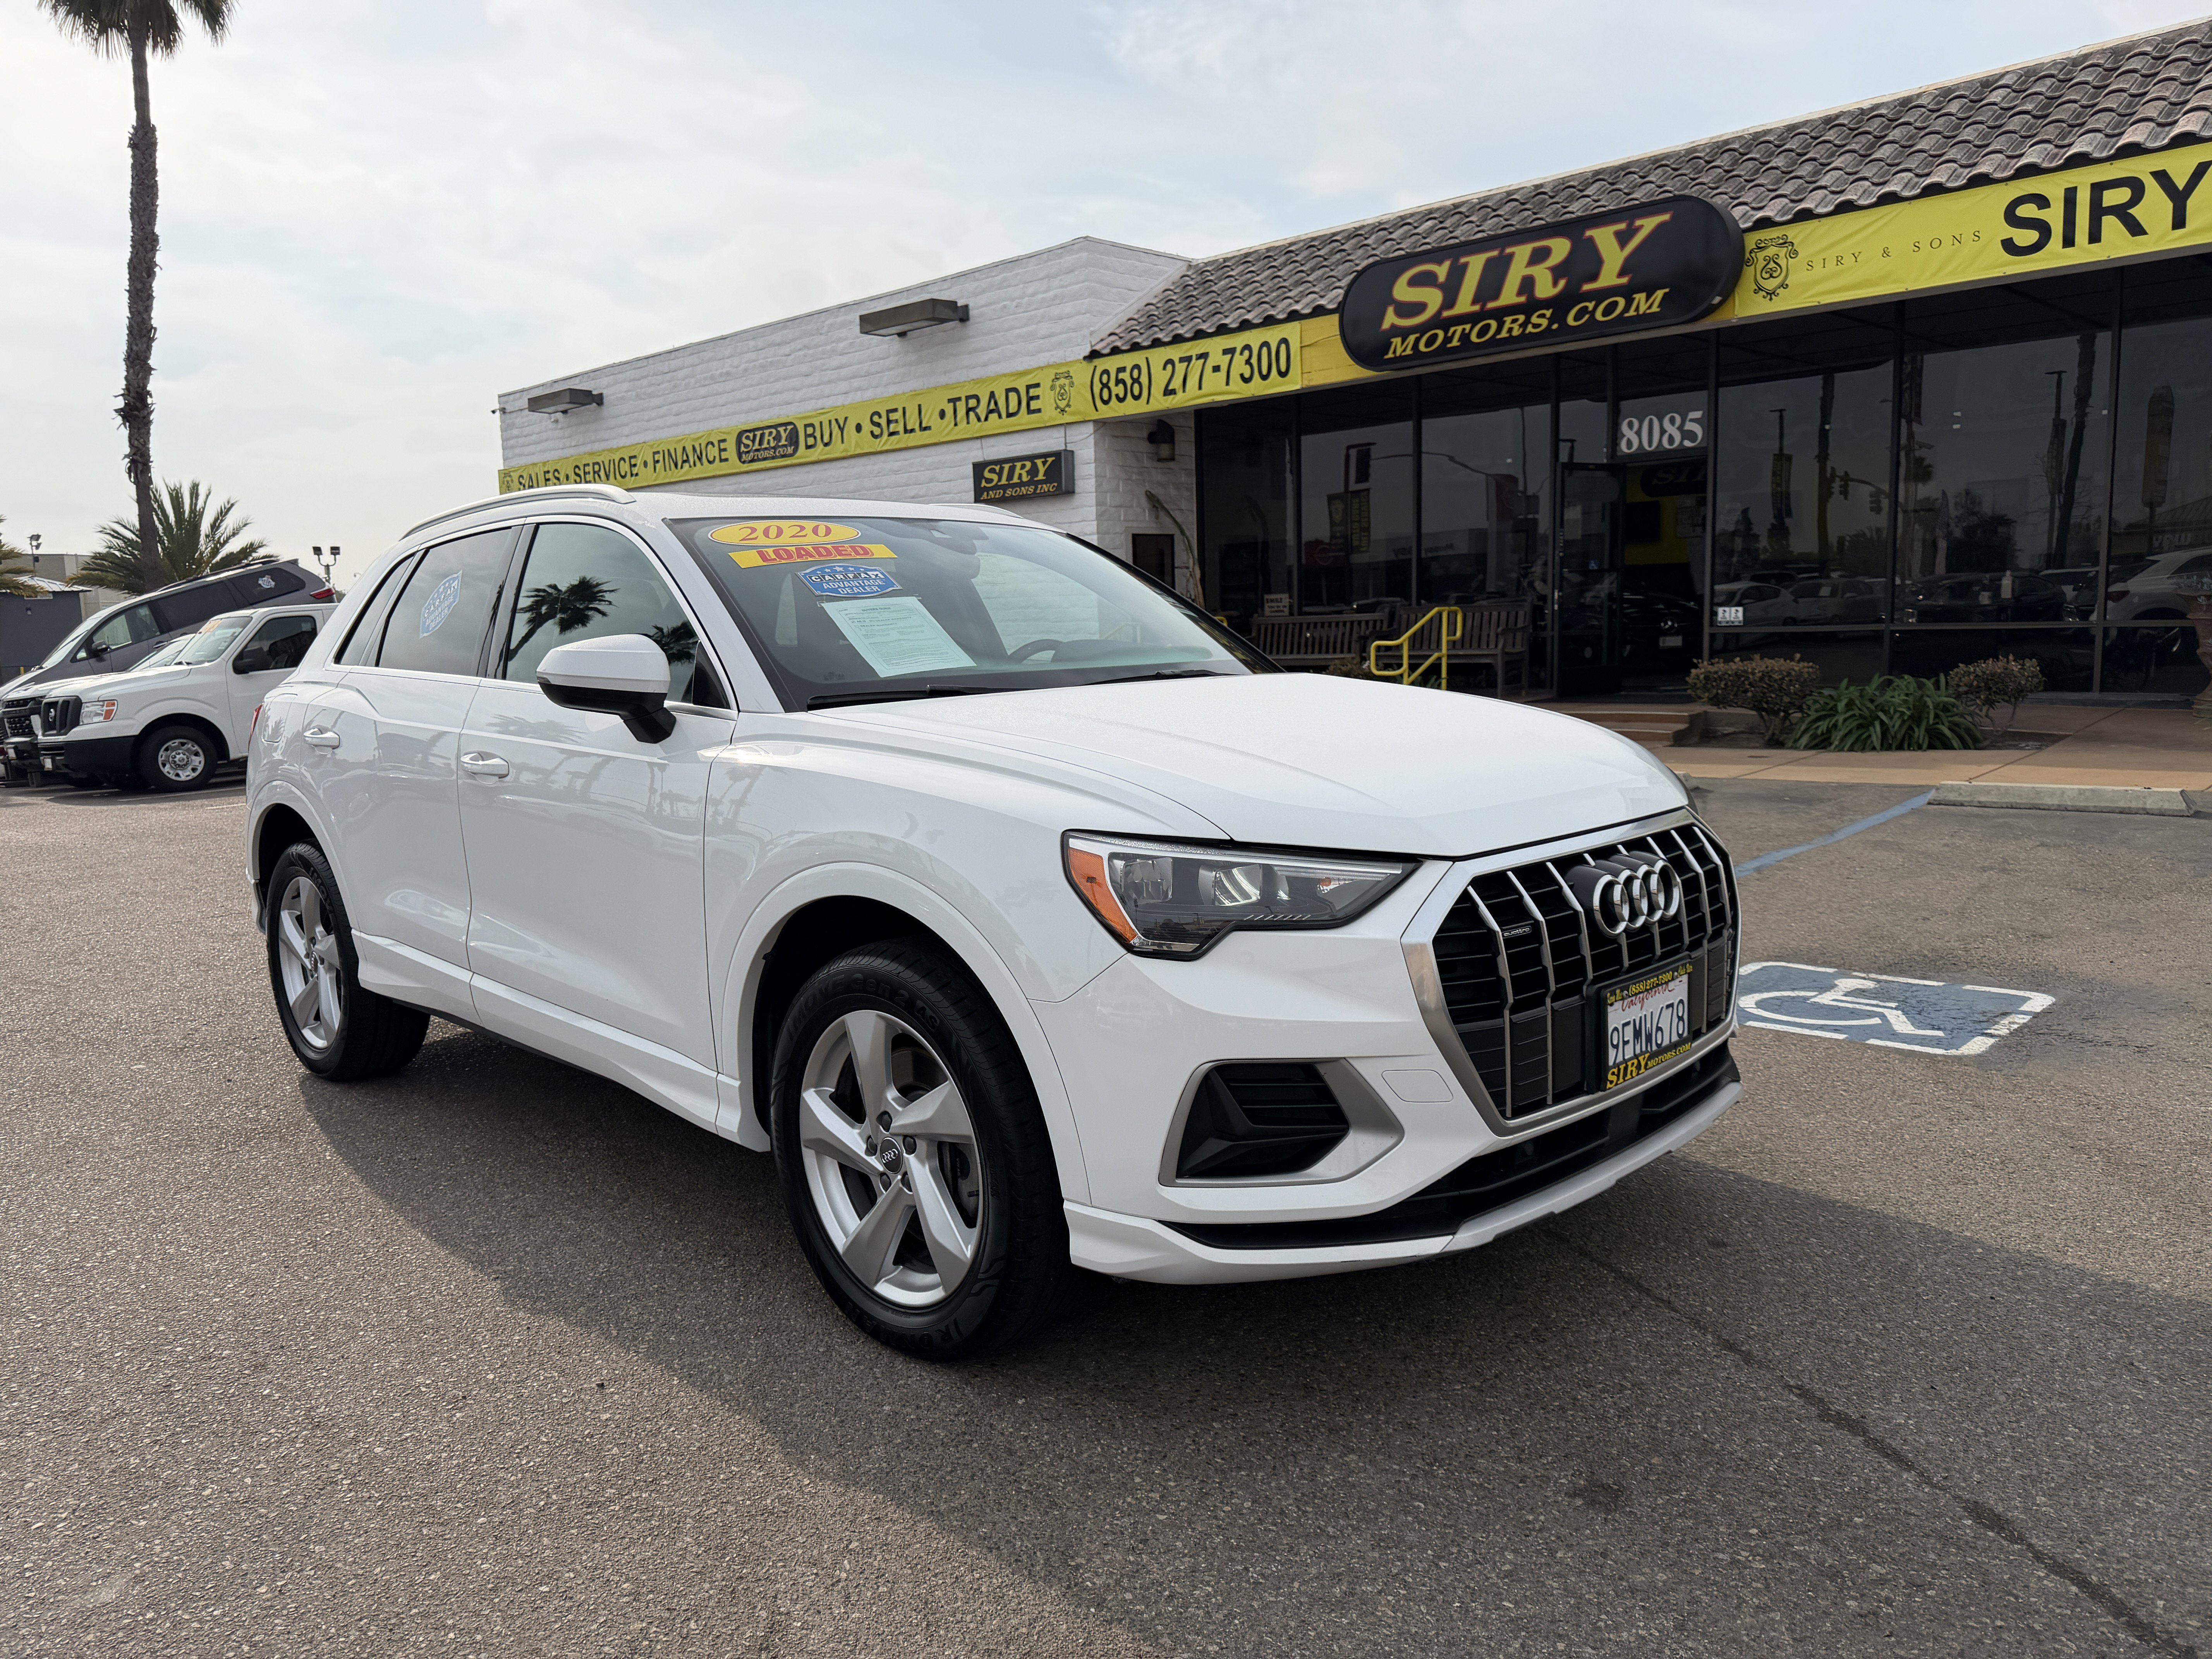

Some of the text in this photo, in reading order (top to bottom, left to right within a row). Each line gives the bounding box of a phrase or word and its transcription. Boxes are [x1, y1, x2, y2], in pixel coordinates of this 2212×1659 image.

[2000, 160, 2212, 258] SIRY
[1806, 230, 1981, 271] SIRY & SONS
[1380, 211, 1673, 331] SIRY
[1090, 337, 1291, 412] (858) 277-7300
[803, 383, 1042, 450] BUY SELL TRADE
[1620, 410, 1703, 453] 8085
[740, 425, 794, 452] SIRY
[742, 446, 794, 461] MOTORS.COM
[574, 455, 639, 484] SERVICE
[652, 438, 729, 474] FINANCE
[981, 457, 1056, 488] SIRY
[980, 483, 1058, 500] AND SONS INC
[738, 524, 832, 542] 2020
[756, 544, 874, 564] LOADED
[809, 571, 884, 582] CARFAX
[823, 579, 886, 589] ADVANTAGE
[838, 585, 881, 594] DEALER
[424, 579, 458, 618] CARFAX
[425, 595, 454, 627] ADVANTAGE
[429, 607, 448, 631] DEALER
[1503, 927, 1530, 936] quattro
[1621, 984, 1675, 1012] California
[1629, 980, 1646, 996] (858)
[1646, 971, 1672, 989] 277-7300
[852, 973, 891, 998] Gen
[894, 989, 909, 1007] 2
[914, 999, 940, 1032] AS
[1610, 998, 1685, 1066] 9EMW678
[1606, 1042, 1692, 1089] SIRY MOTORS.COM
